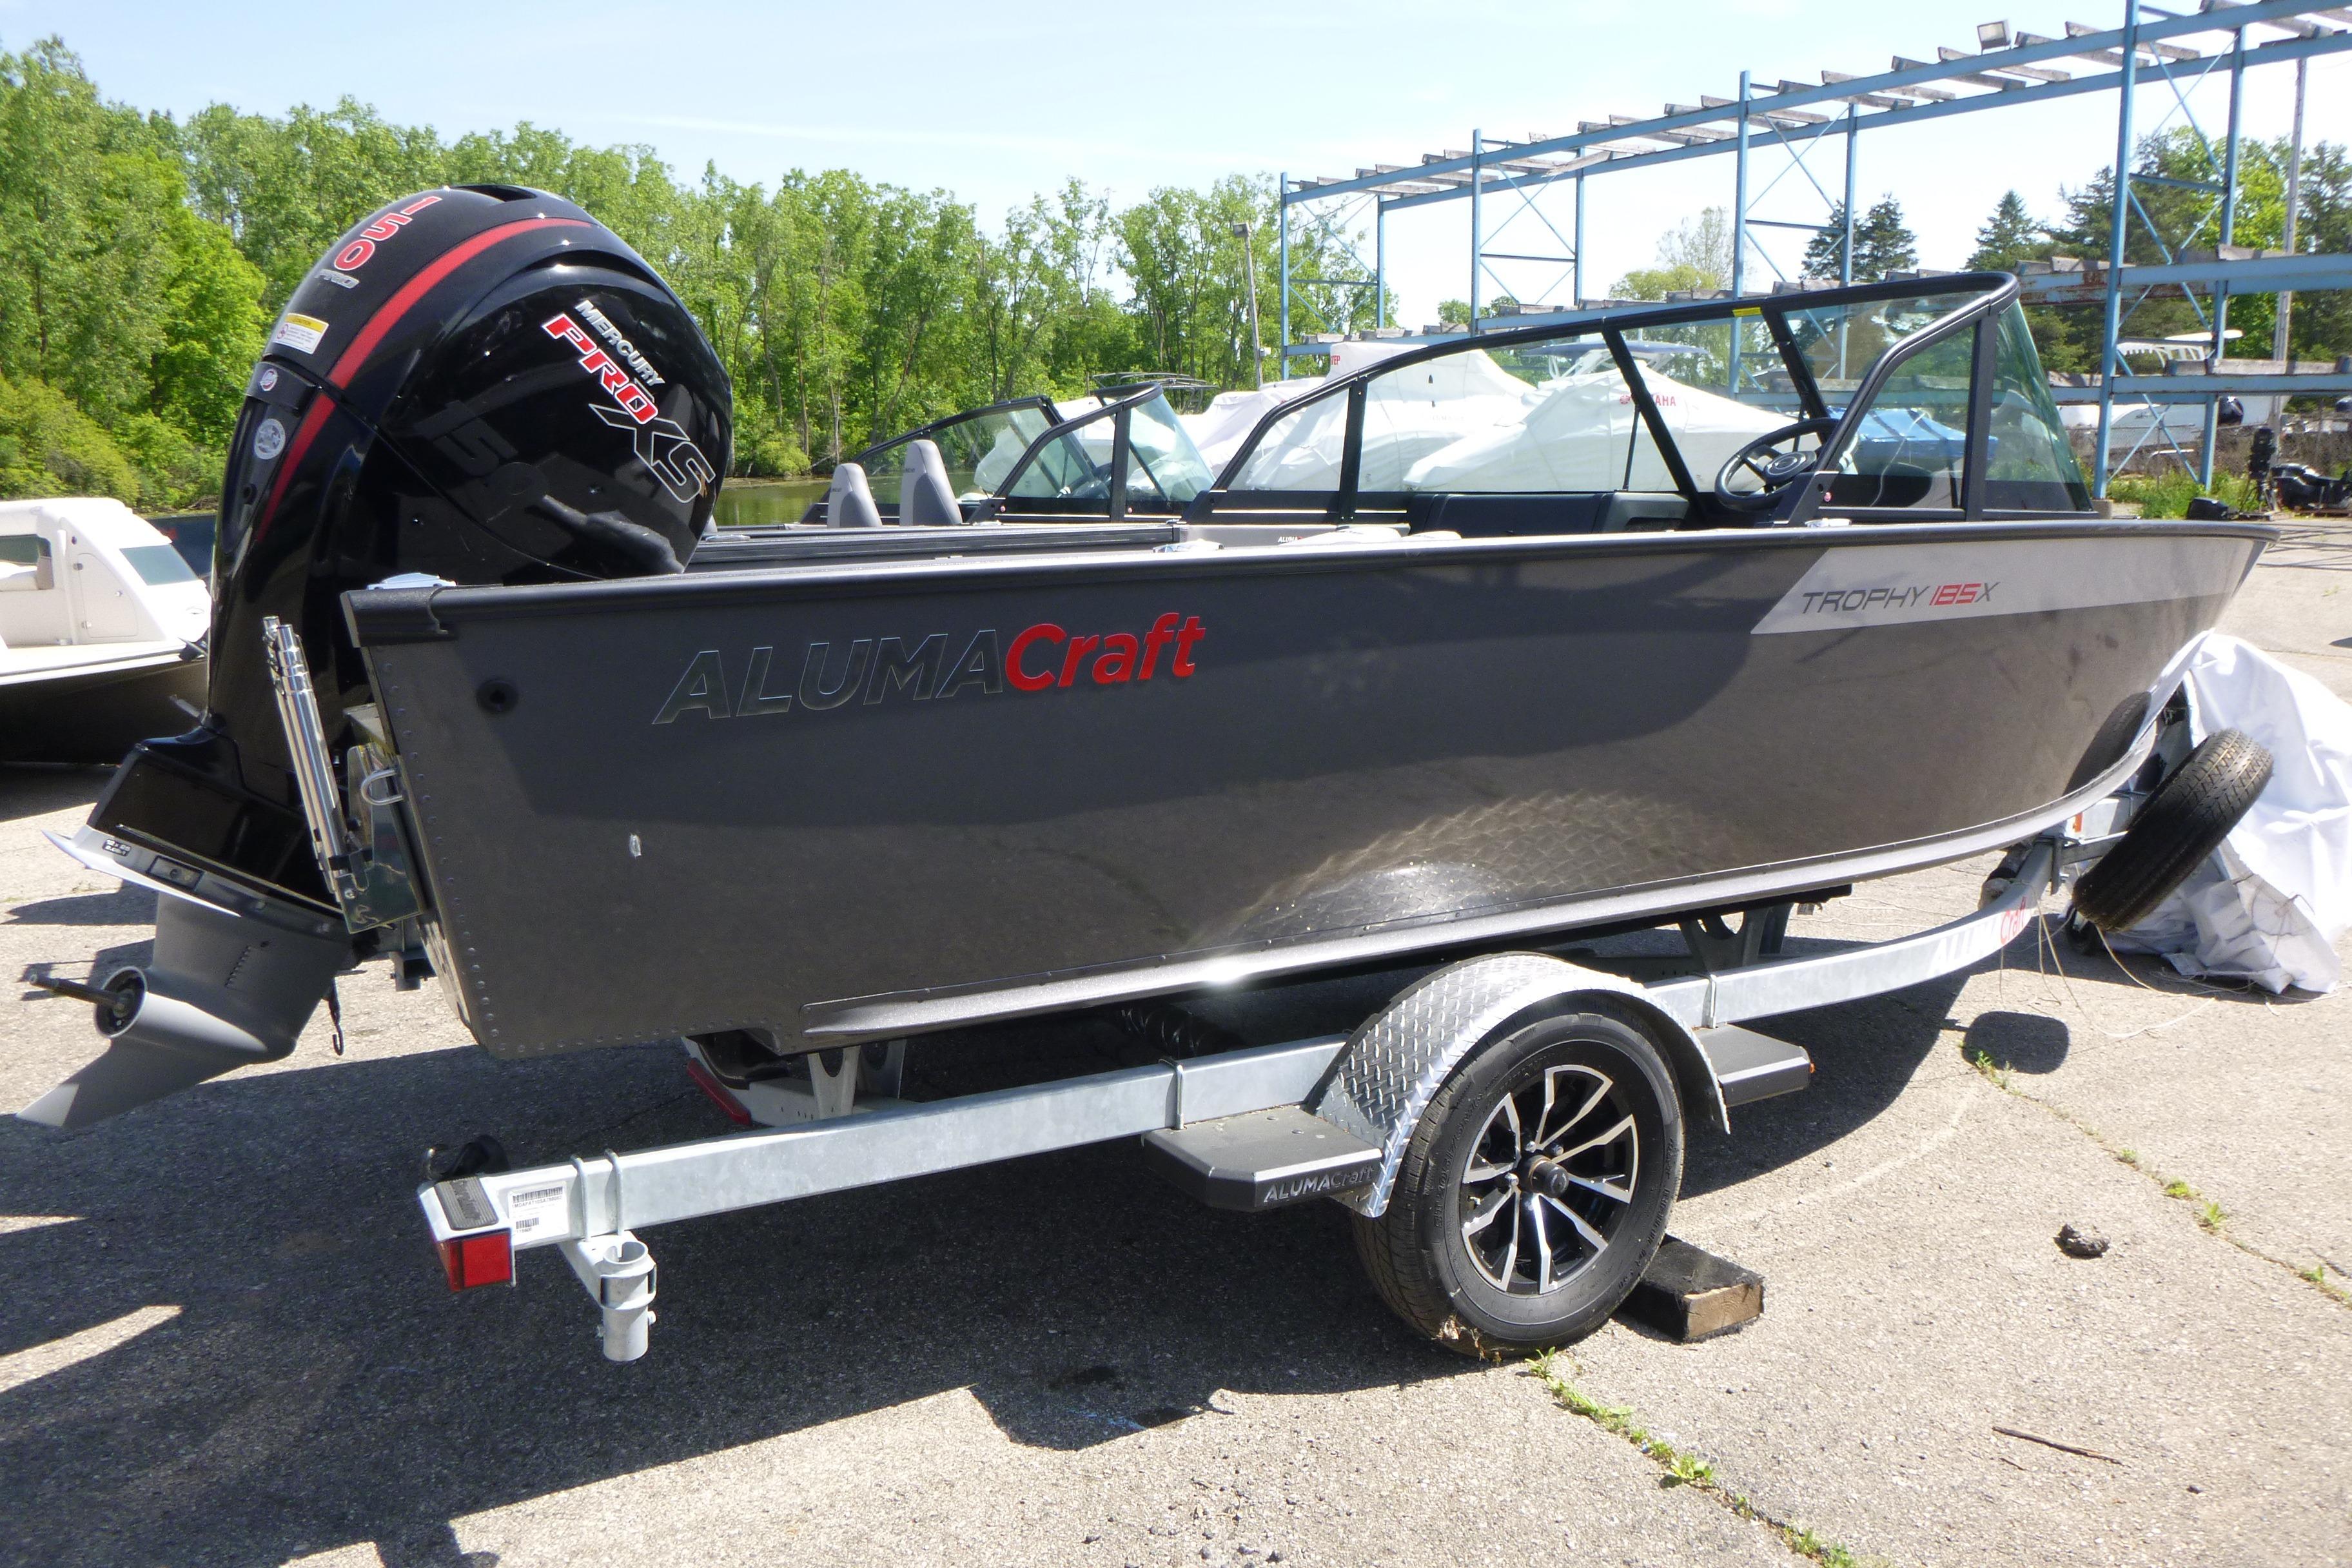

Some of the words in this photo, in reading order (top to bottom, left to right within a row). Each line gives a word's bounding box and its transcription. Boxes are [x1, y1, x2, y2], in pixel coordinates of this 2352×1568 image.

[334, 195, 443, 271] 150
[542, 313, 659, 425] PRO
[574, 300, 665, 387] MERCURY
[588, 378, 716, 504] XS
[1655, 395, 1676, 407] AHA
[1801, 585, 1930, 614] TROPHY
[652, 612, 1206, 725] ALUMACraft
[1264, 1164, 1375, 1203] ALUMACraft
